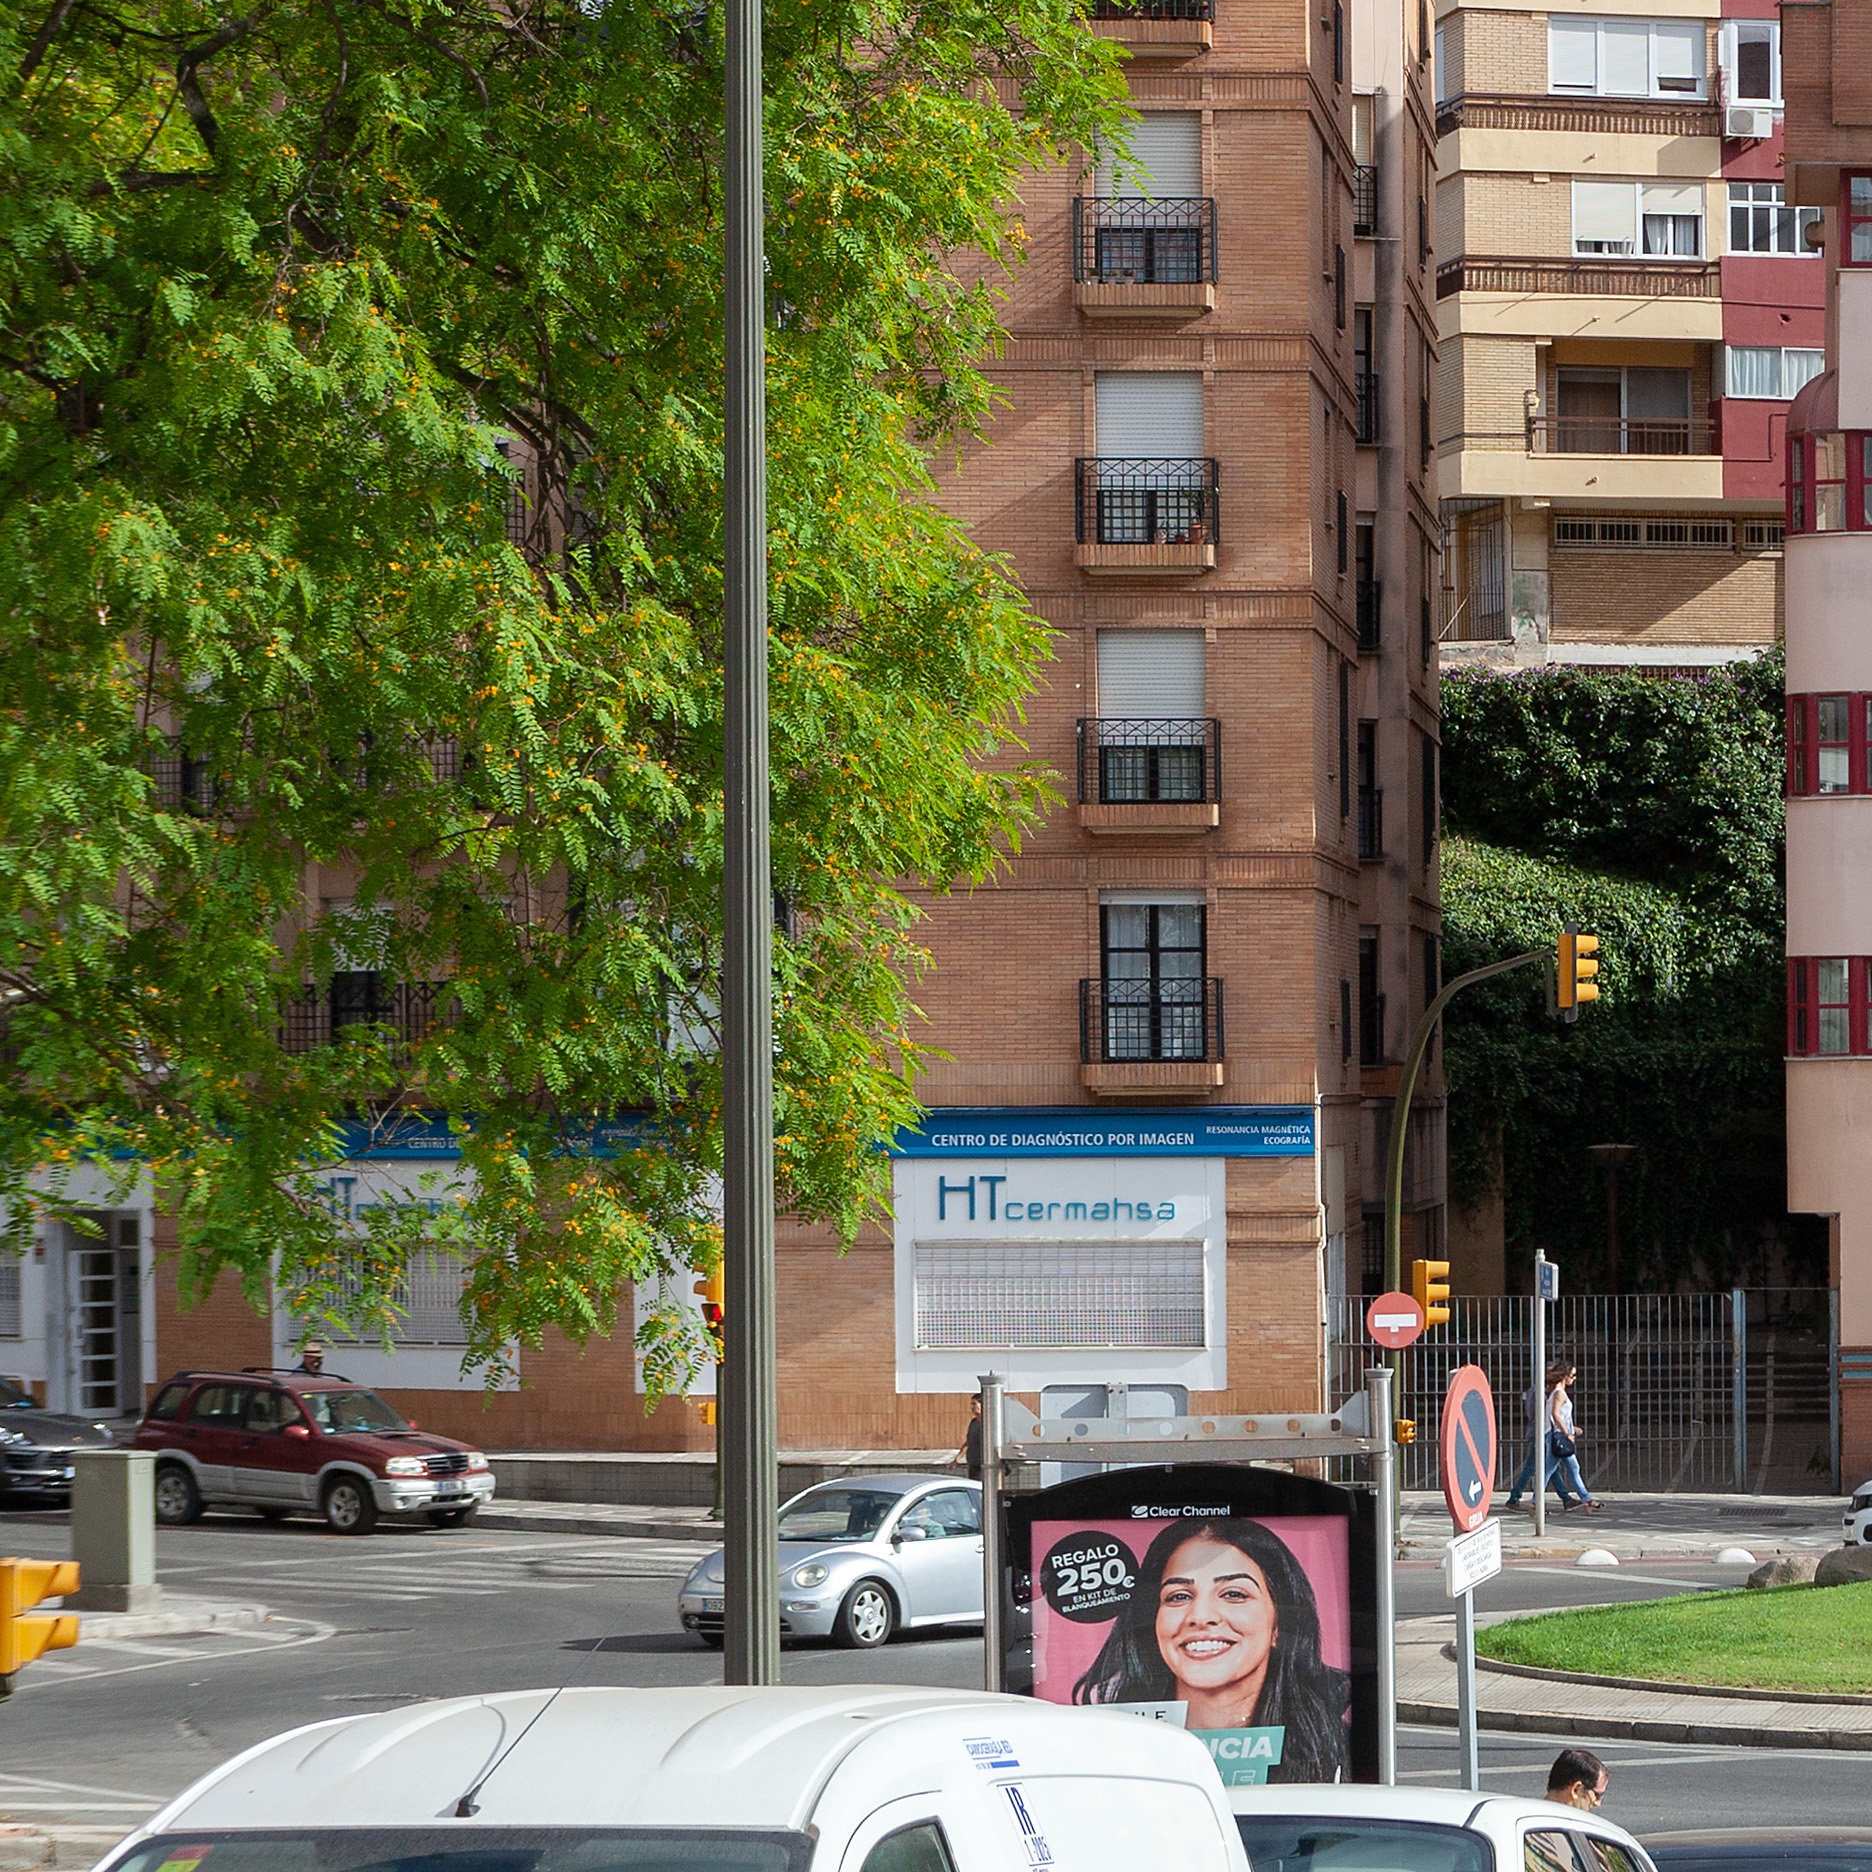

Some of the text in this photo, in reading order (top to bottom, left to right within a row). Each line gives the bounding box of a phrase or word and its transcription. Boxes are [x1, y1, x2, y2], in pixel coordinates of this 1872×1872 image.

[932, 1129, 1195, 1146] CENTRO DE DIAGNÓSTICO POR IMAGEN
[1206, 1124, 1311, 1134] RESONANCIA MAGNÉTICA
[1263, 1134, 1311, 1145] ECOGRAFÍA
[1149, 1504, 1231, 1517] Clear Channel
[1051, 1544, 1119, 1569] REGALO
[1062, 1592, 1131, 1613] BLANQUEAMIENTO
[1073, 1587, 1116, 1604] EN KIT DE
[1005, 1787, 1036, 1835] IR
